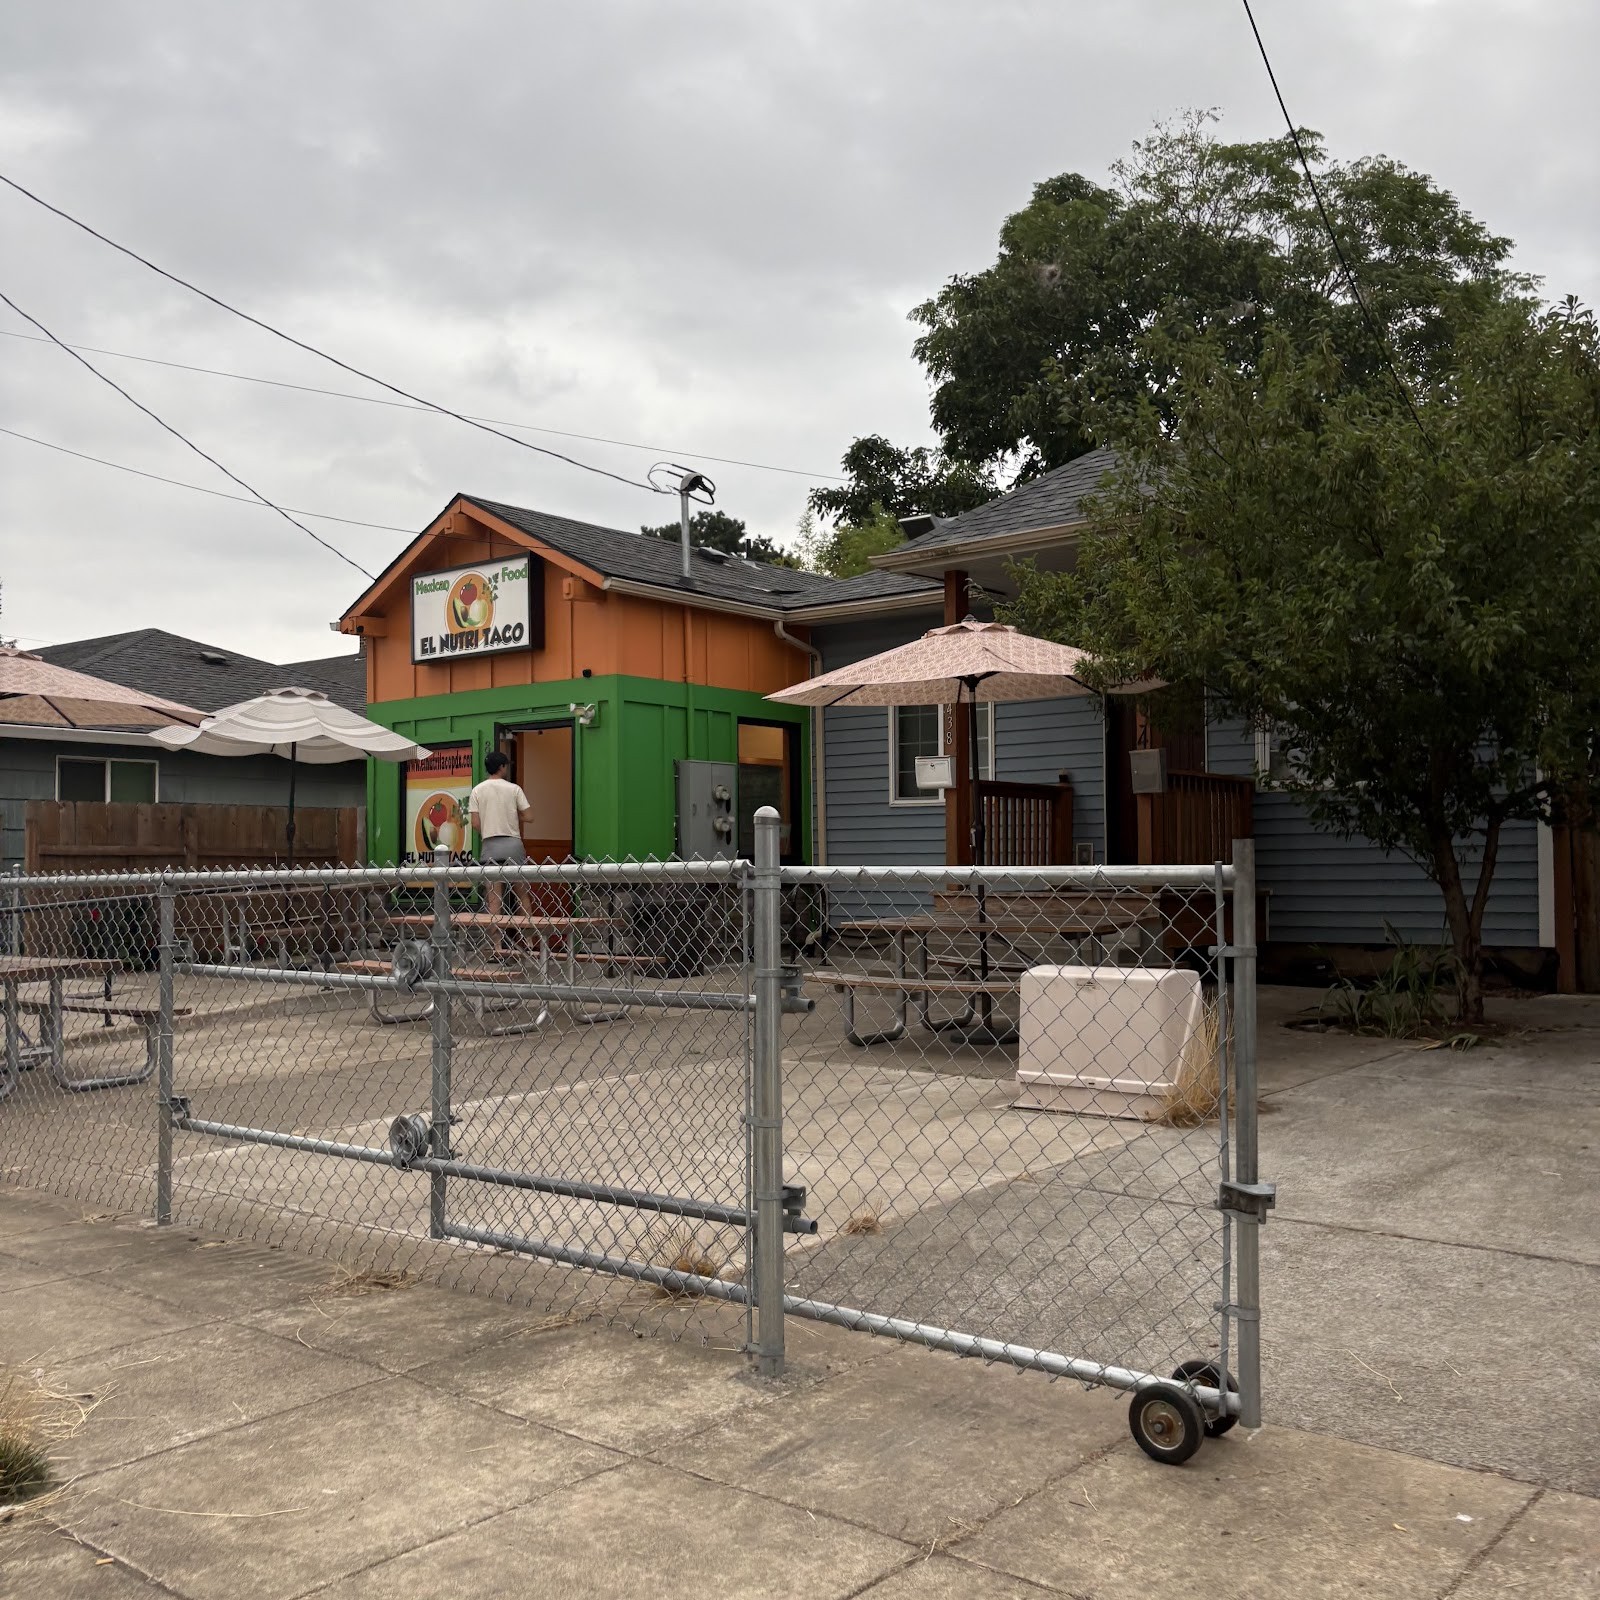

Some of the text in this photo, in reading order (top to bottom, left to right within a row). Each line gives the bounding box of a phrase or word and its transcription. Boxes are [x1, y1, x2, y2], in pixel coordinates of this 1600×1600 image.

[415, 562, 528, 595] Mexican Food
[420, 622, 525, 655] EL NUTRI TACO
[405, 851, 416, 864] EL
